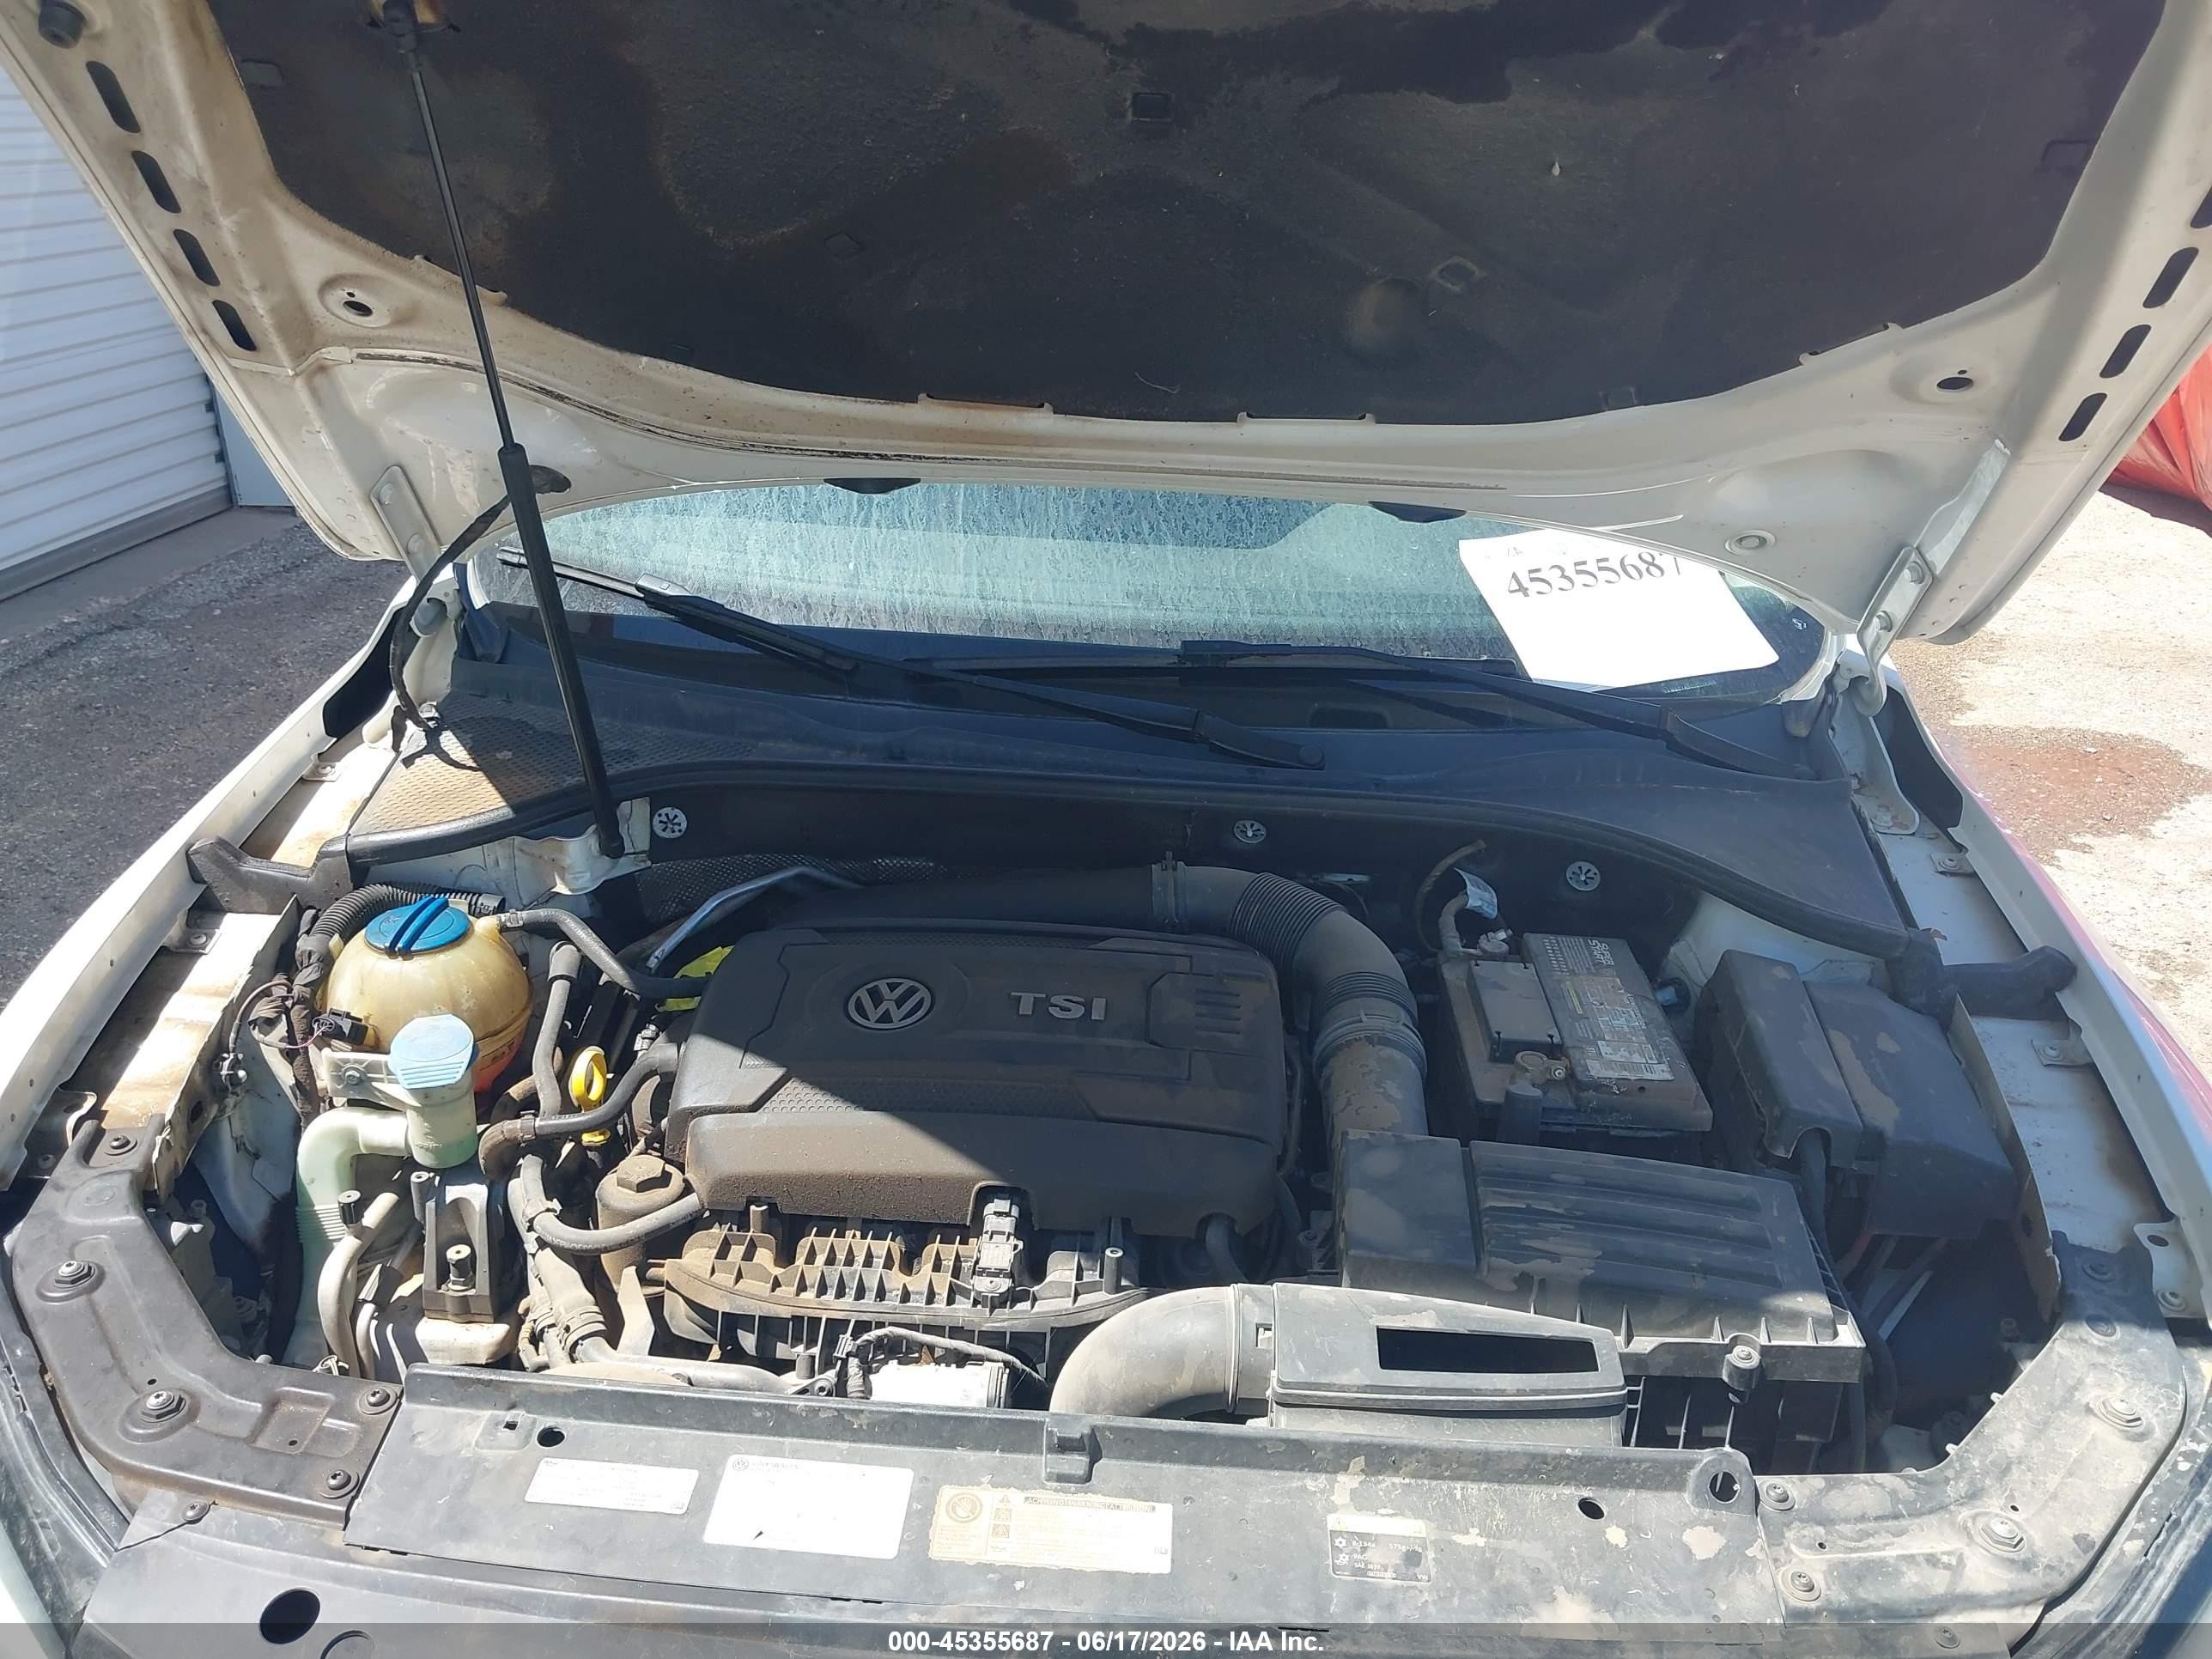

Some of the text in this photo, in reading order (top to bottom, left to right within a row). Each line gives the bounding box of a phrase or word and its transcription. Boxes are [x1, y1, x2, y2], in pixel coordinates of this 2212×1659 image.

[1588, 939, 1607, 965] START
[1601, 942, 1615, 966] SUPER
[1010, 992, 1108, 1021] TSI
